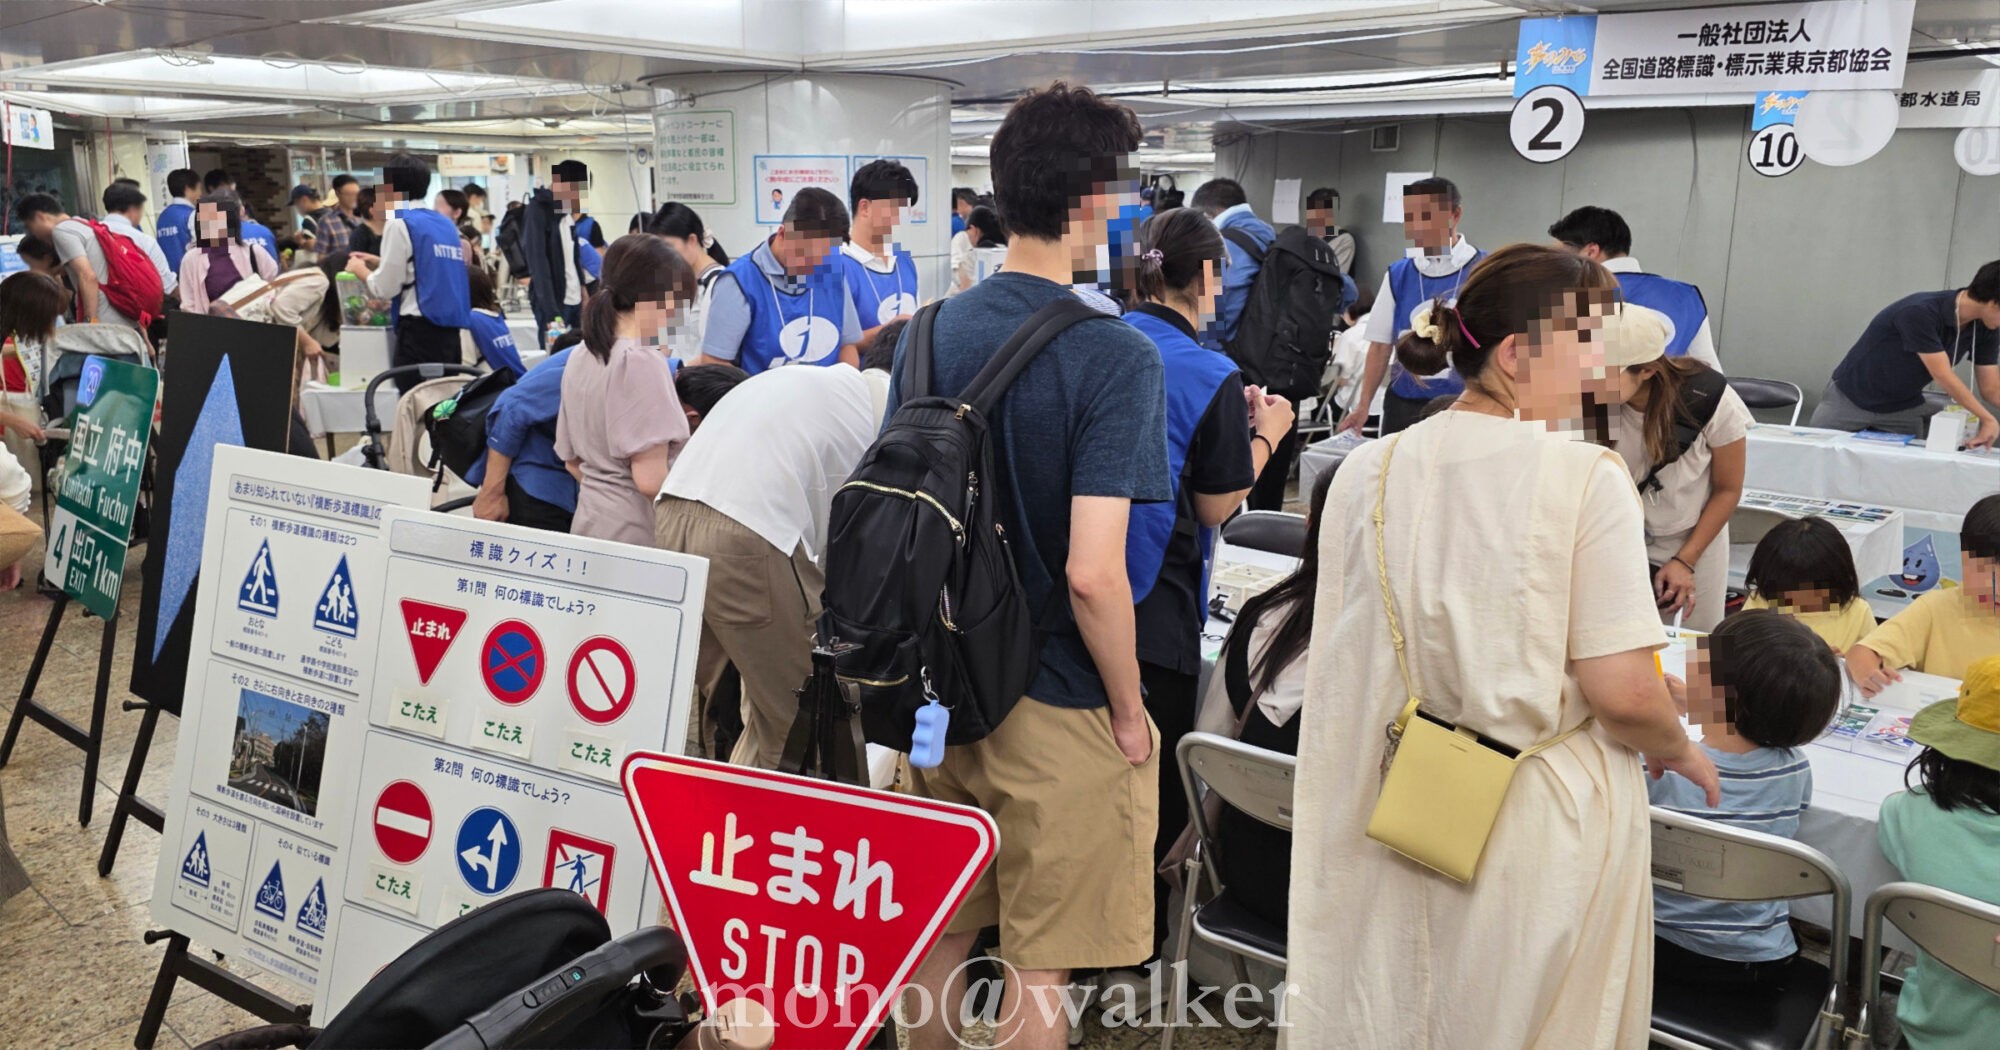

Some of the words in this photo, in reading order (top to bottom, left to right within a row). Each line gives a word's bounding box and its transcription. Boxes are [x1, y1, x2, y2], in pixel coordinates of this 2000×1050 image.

[1677, 18, 1812, 47] 一般社団法人
[1602, 46, 1893, 81] 全国道路標識・標示業東京都協会
[1894, 90, 1981, 108] 都水道局
[1527, 97, 1565, 151] 2
[1755, 131, 1799, 168] 10
[86, 374, 99, 393] 20
[70, 412, 105, 467] 国立
[102, 422, 143, 484] 府中
[61, 470, 96, 510] Kunitachi
[96, 487, 129, 527] Fuchu
[53, 524, 68, 569] 4
[68, 566, 88, 595] EXIT
[71, 527, 96, 570] 出口
[94, 548, 120, 602] 1km
[456, 577, 488, 598] 第1問
[494, 584, 597, 617] 何の標識でしょう？
[247, 616, 265, 629] おとな
[410, 617, 452, 641] 止まれ
[324, 635, 344, 649] こども
[400, 699, 439, 725] こたえ
[483, 720, 524, 746] こたえ
[570, 741, 613, 768] こたえ
[434, 756, 464, 779] 第2問
[470, 767, 571, 806] 何の標識でしょう？
[689, 812, 904, 922] 止まれ
[374, 872, 413, 900] こたえ
[720, 917, 865, 1007] STOP
